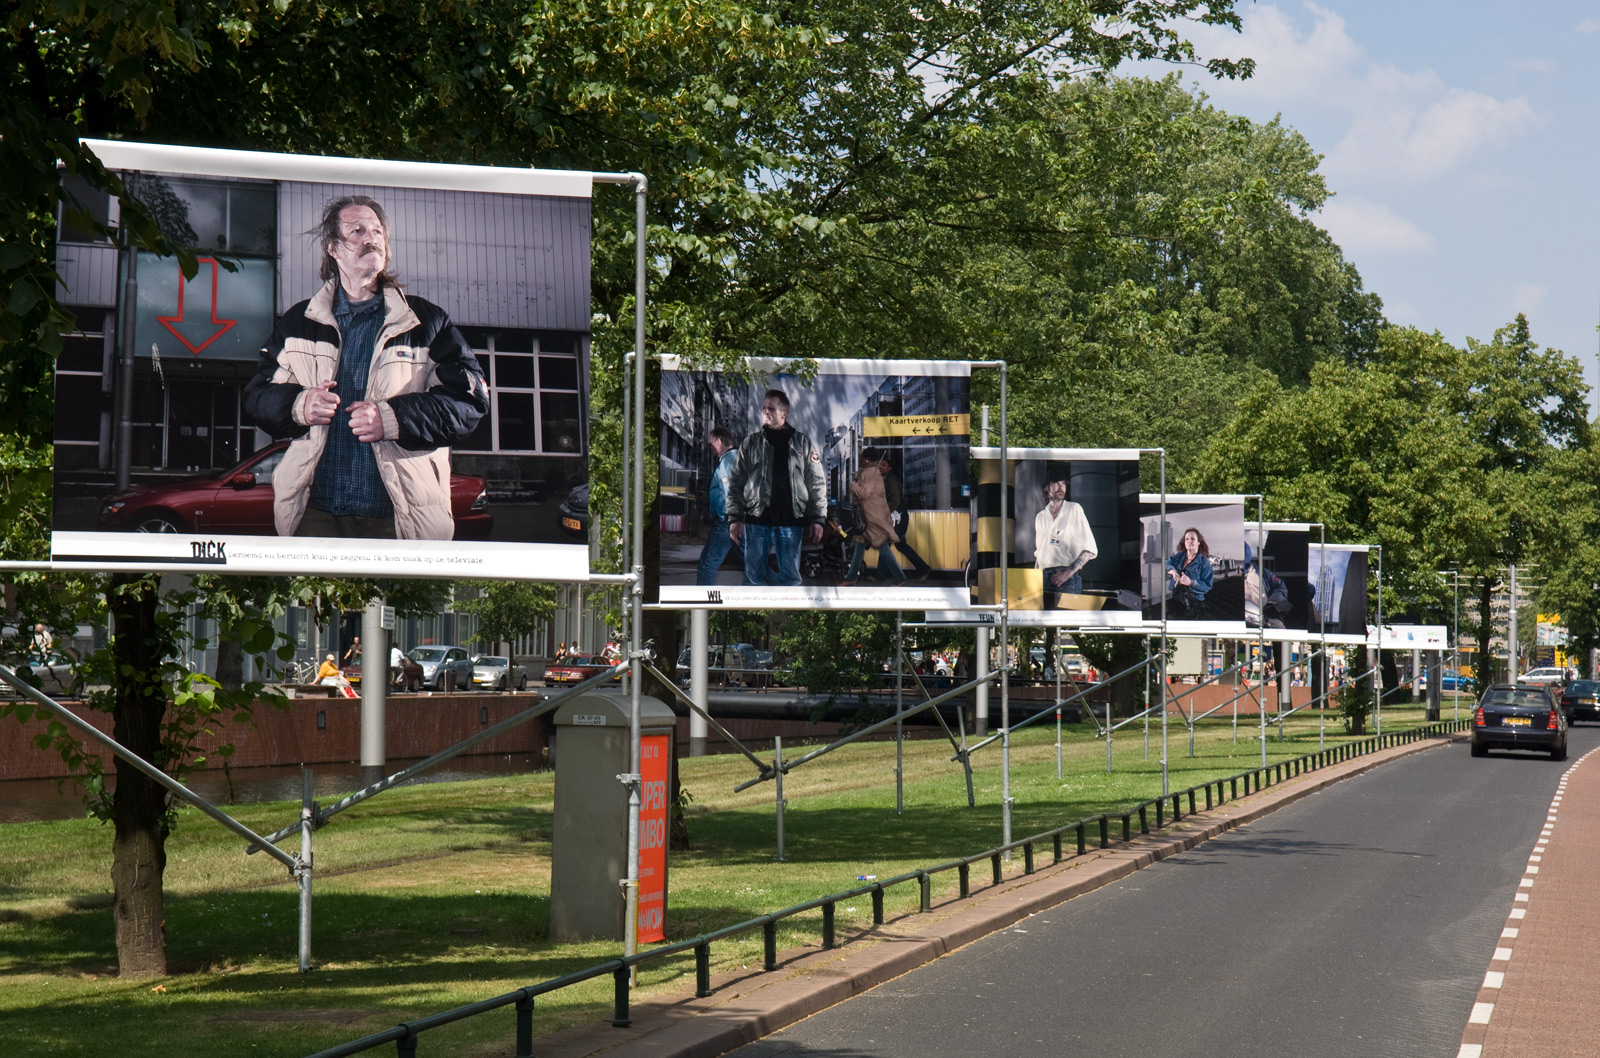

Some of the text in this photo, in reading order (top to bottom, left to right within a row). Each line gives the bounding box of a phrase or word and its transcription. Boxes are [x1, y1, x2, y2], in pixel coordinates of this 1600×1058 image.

[190, 540, 227, 560] DICK
[276, 552, 310, 560] berucht
[311, 552, 328, 560] kun
[329, 553, 339, 562] je
[384, 554, 401, 562] kom
[402, 555, 422, 563] vaak
[424, 556, 434, 564] op
[435, 555, 445, 563] de
[446, 556, 484, 564] televisie
[640, 780, 665, 811] UPER
[639, 817, 665, 850] MBO
